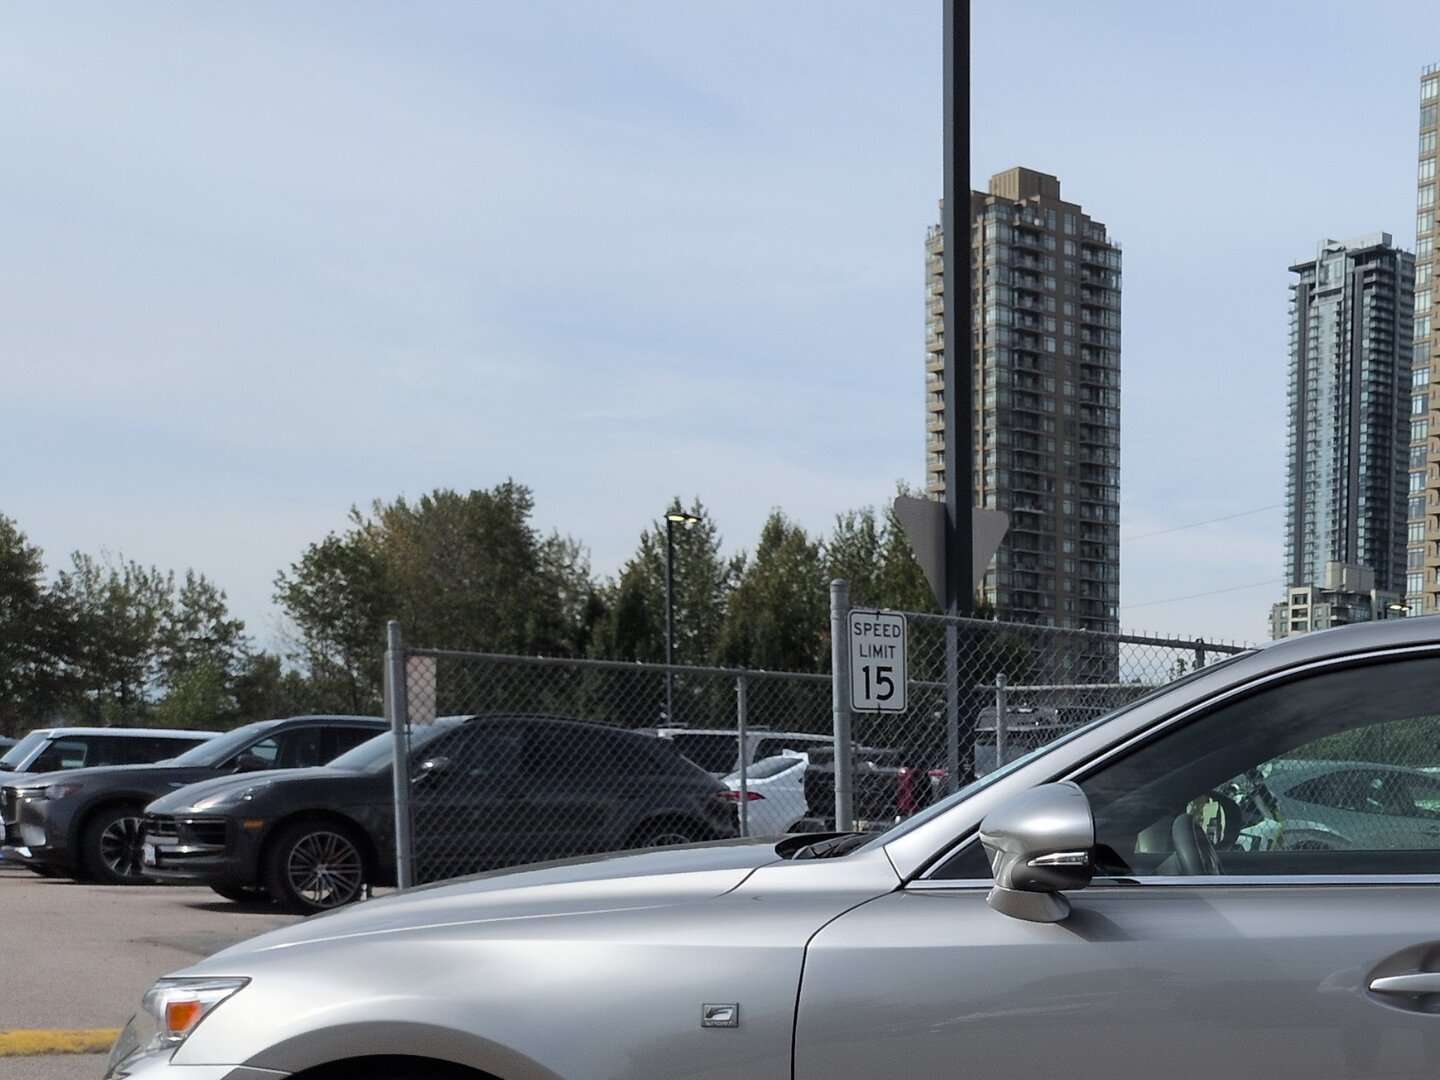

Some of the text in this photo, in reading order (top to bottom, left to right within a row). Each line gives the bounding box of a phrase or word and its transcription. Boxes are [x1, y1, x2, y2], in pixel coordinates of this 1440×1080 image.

[854, 622, 901, 638] SPEED
[860, 644, 896, 659] LIMIT
[862, 665, 895, 701] 15
